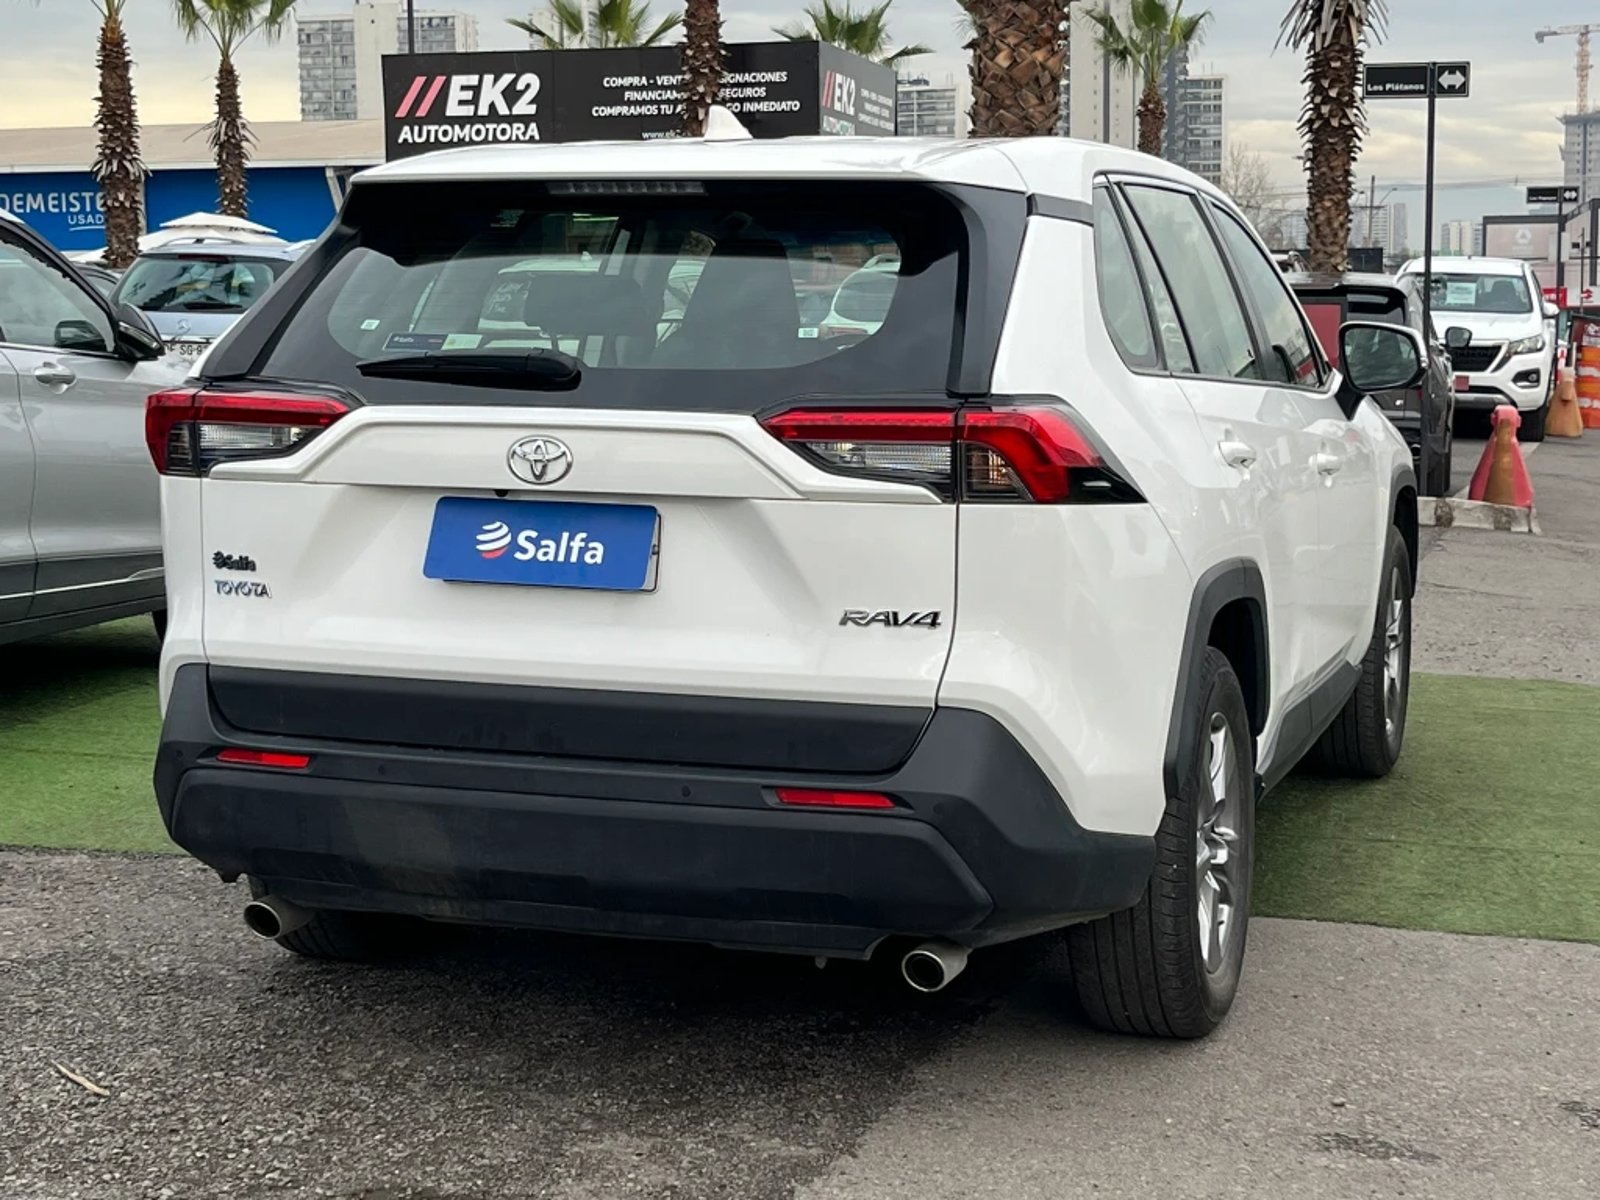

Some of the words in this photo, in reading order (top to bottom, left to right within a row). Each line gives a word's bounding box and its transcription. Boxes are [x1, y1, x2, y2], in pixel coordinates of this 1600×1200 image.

[602, 77, 648, 88] COMPRA
[655, 75, 685, 86] VENT
[591, 104, 658, 117] COMPRAMOS
[659, 104, 674, 115] TU
[742, 101, 801, 112] INMEDIATO
[397, 122, 541, 144] AUTOMOTORA
[0, 191, 108, 214] DEMEISTE
[67, 213, 105, 225] USAD
[513, 529, 605, 565] Salfa
[214, 579, 273, 599] TOYOTA
[838, 610, 942, 629] RAV4
